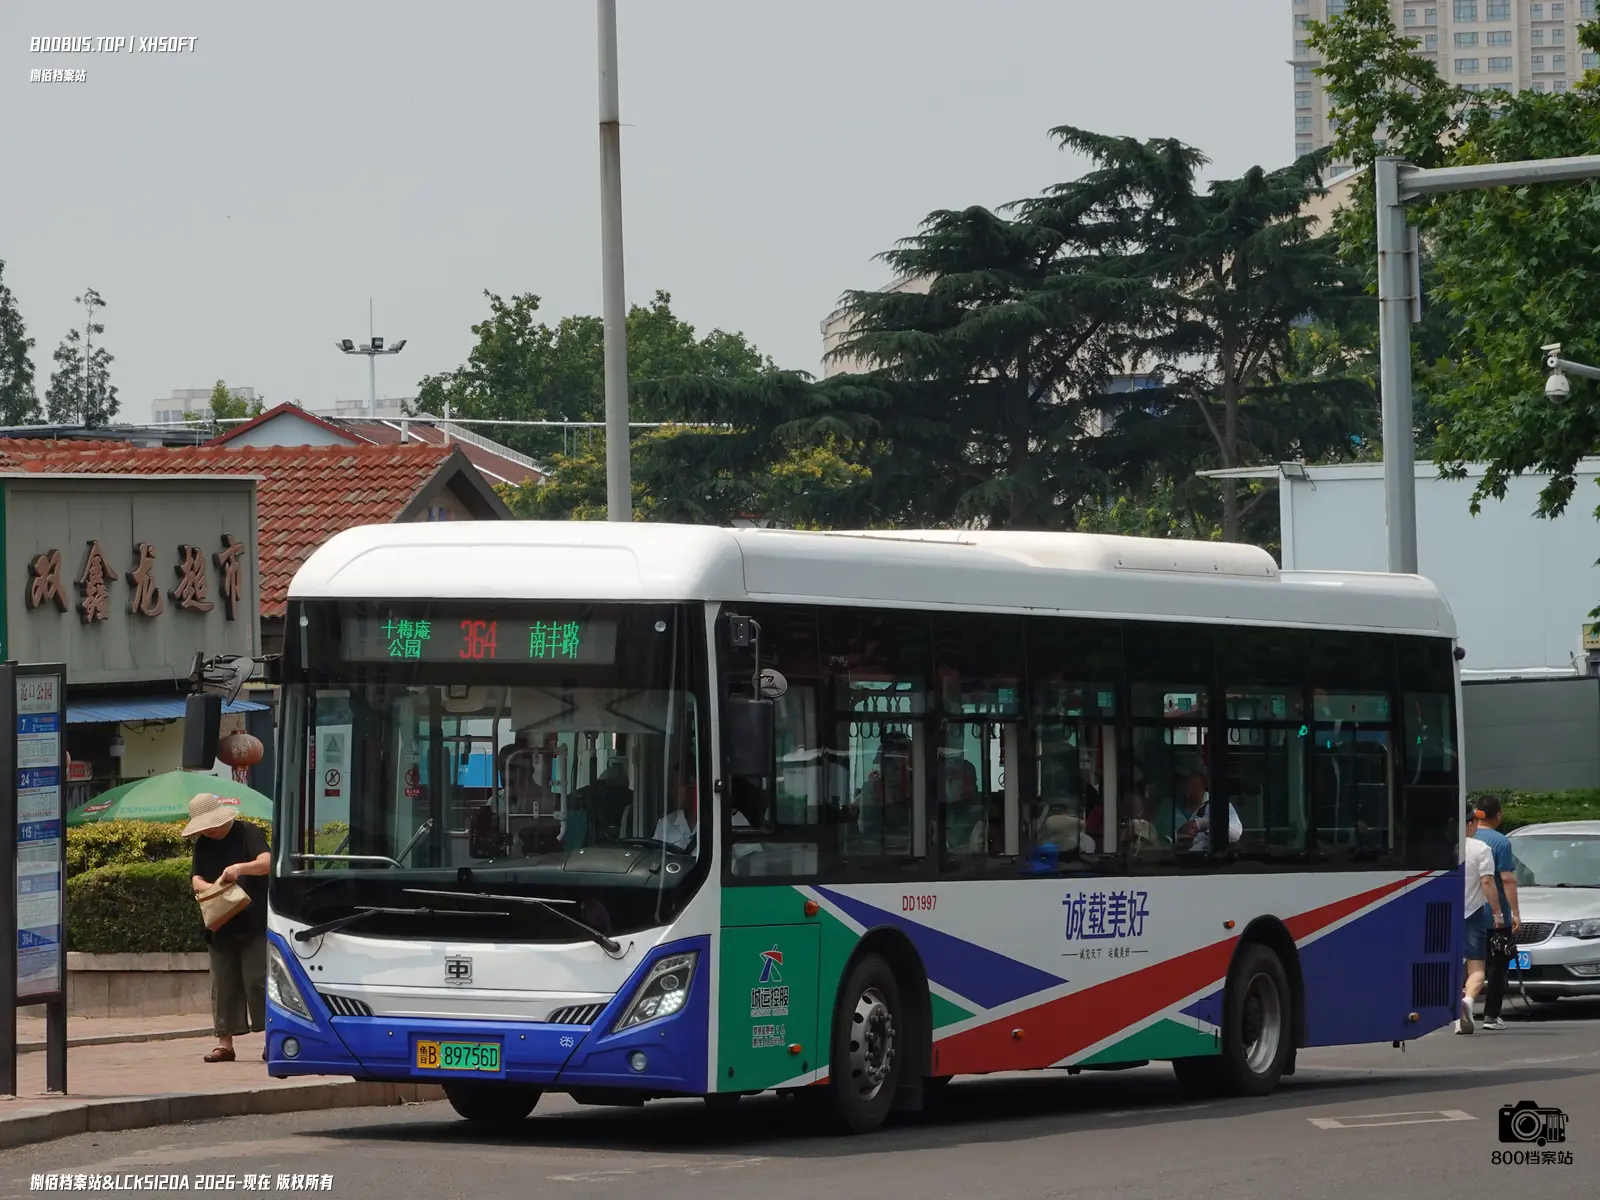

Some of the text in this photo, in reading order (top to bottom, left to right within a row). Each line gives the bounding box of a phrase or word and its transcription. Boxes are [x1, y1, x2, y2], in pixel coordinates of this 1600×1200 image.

[381, 619, 580, 660] 十梅庵 364 南丰路
[387, 639, 422, 659] 公园
[21, 718, 27, 731] 7
[20, 772, 30, 787] 24
[21, 826, 33, 840] 115
[20, 879, 32, 893] 302
[902, 895, 938, 912] DD1997
[1062, 890, 1150, 941] 诚载美好
[21, 932, 34, 946] 364
[750, 986, 790, 1009] 城运控股
